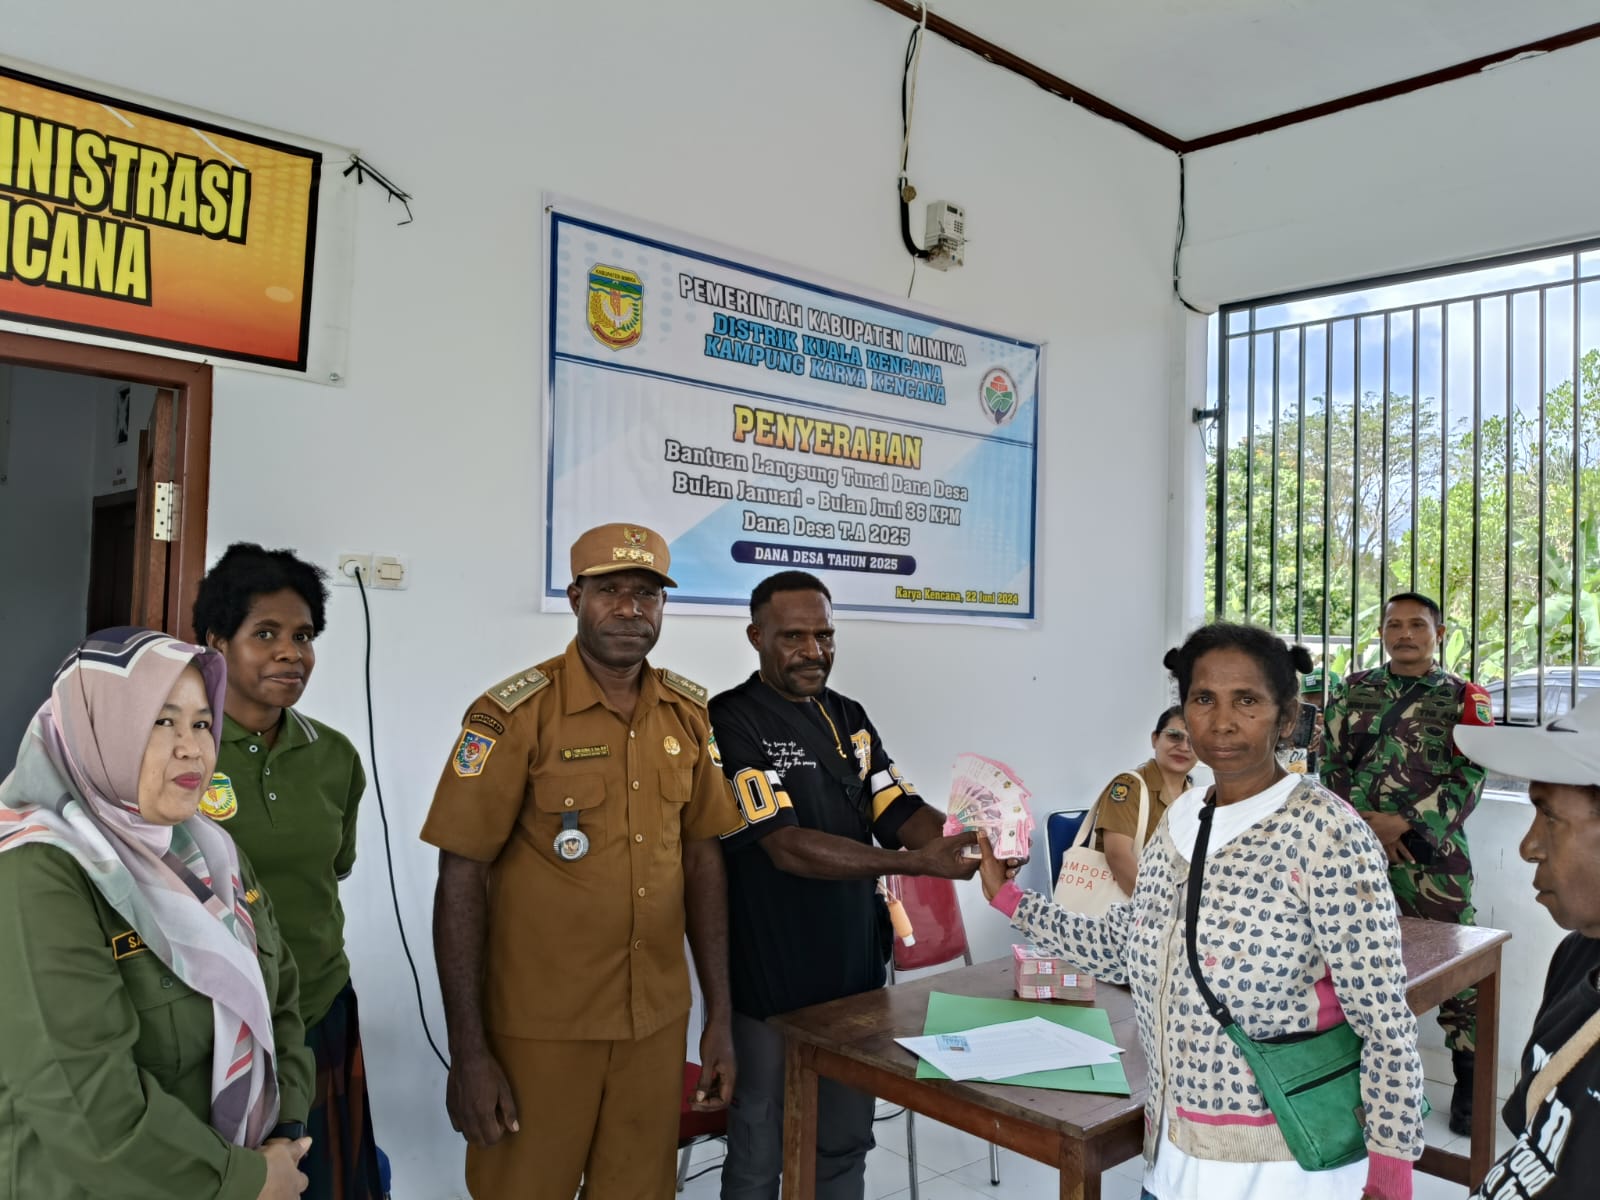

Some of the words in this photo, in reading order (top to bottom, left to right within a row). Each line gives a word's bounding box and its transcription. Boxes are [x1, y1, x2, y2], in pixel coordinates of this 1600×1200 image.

[679, 273, 802, 327] PEMERINTAH
[808, 308, 903, 352] KABUPATEN
[907, 333, 967, 366] MIMIKA
[704, 333, 805, 375] KAMPUNG
[810, 357, 867, 389] KARYA
[871, 371, 946, 405] KENCANA
[713, 312, 798, 352] DISTRIK
[802, 335, 862, 367] KUALA
[866, 349, 943, 384] KENCANA
[733, 404, 922, 469] PENYERAHAN
[665, 439, 748, 472] Bantuan
[752, 453, 838, 488] Langsung
[842, 466, 888, 491] Tunai
[892, 474, 931, 496] Dana
[934, 480, 968, 501] Desa
[673, 471, 733, 499] Bulan
[736, 480, 802, 508] Januari
[819, 491, 866, 515] Bulan
[870, 498, 902, 519] Juni
[905, 502, 926, 522] 36
[930, 504, 961, 526] KPM
[743, 510, 789, 534] Dana
[794, 516, 835, 539] Desa
[838, 521, 865, 542] T.A
[869, 524, 910, 546] 2025
[754, 547, 789, 562] DANA
[792, 551, 825, 565] DESA
[827, 555, 866, 568] TAHUN
[869, 557, 898, 570] 2025
[895, 586, 922, 602] Karya
[923, 587, 964, 603] Kencana,
[965, 590, 977, 603] 22
[979, 591, 995, 604] Juni
[997, 592, 1019, 605] 2024
[1060, 873, 1095, 891] ROPA
[1063, 861, 1116, 881] AMPOE
